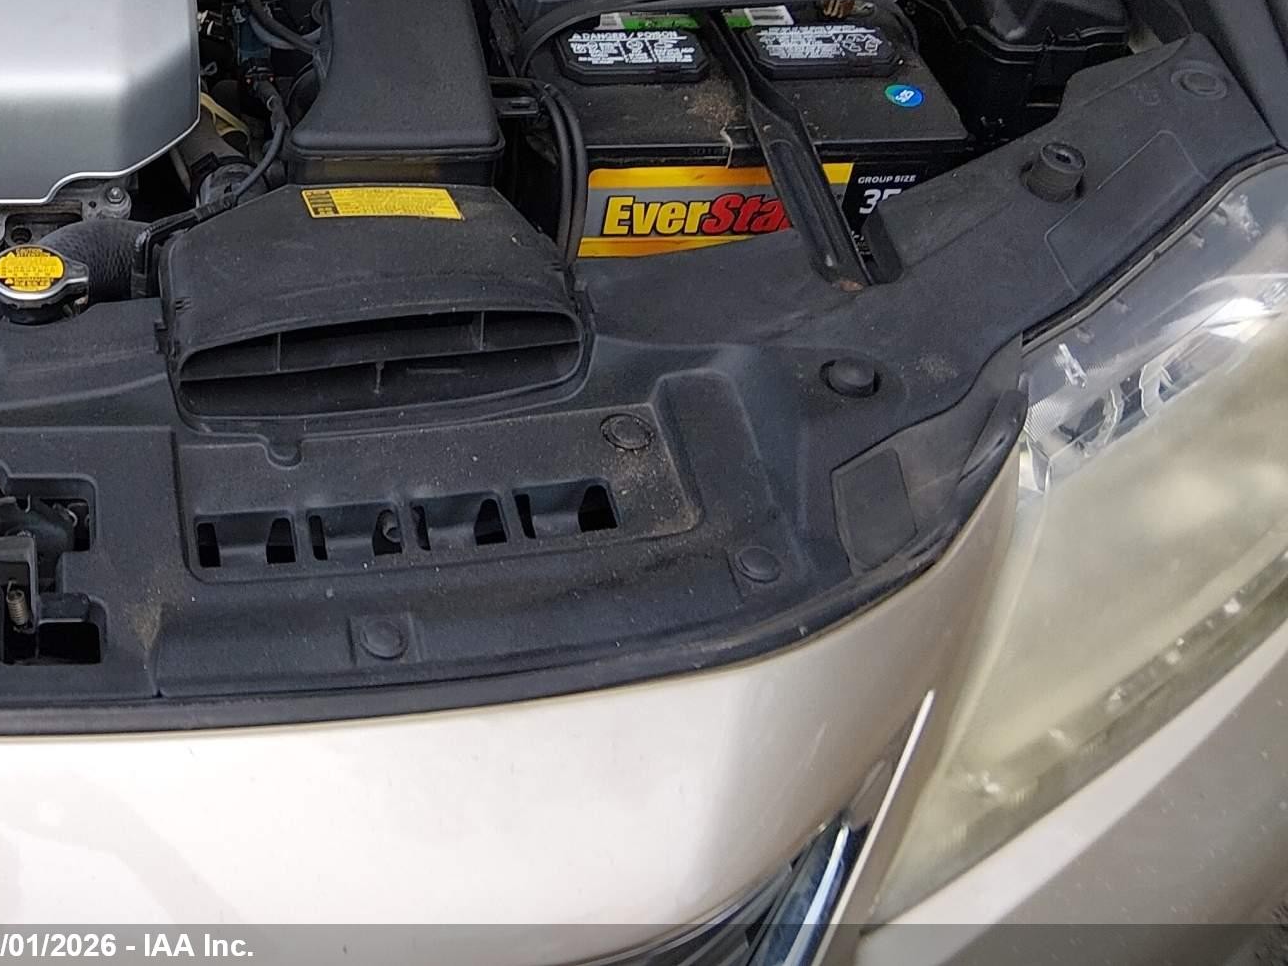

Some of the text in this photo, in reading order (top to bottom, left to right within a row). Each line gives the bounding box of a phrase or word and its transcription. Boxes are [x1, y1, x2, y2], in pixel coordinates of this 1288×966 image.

[857, 174, 916, 184] GROUP SIZE
[602, 194, 794, 237] EverSta
